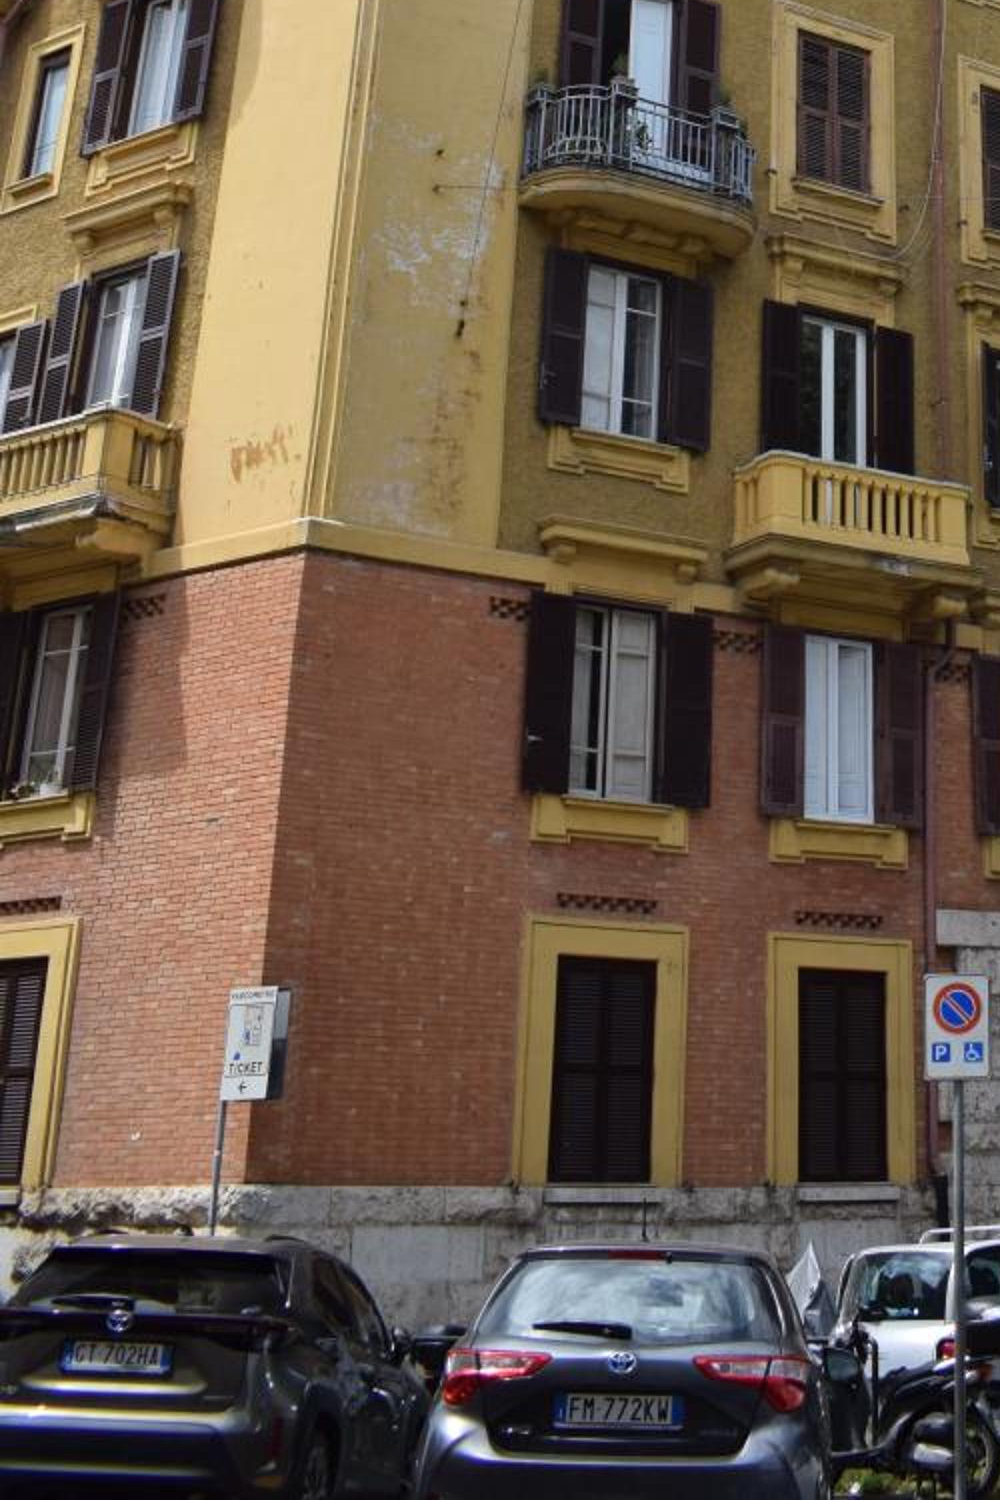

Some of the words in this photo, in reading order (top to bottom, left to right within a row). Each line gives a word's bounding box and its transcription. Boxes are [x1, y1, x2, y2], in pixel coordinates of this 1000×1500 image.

[935, 1046, 947, 1061] P
[229, 1061, 263, 1074] TICKET
[603, 1396, 669, 1422] 772KW
